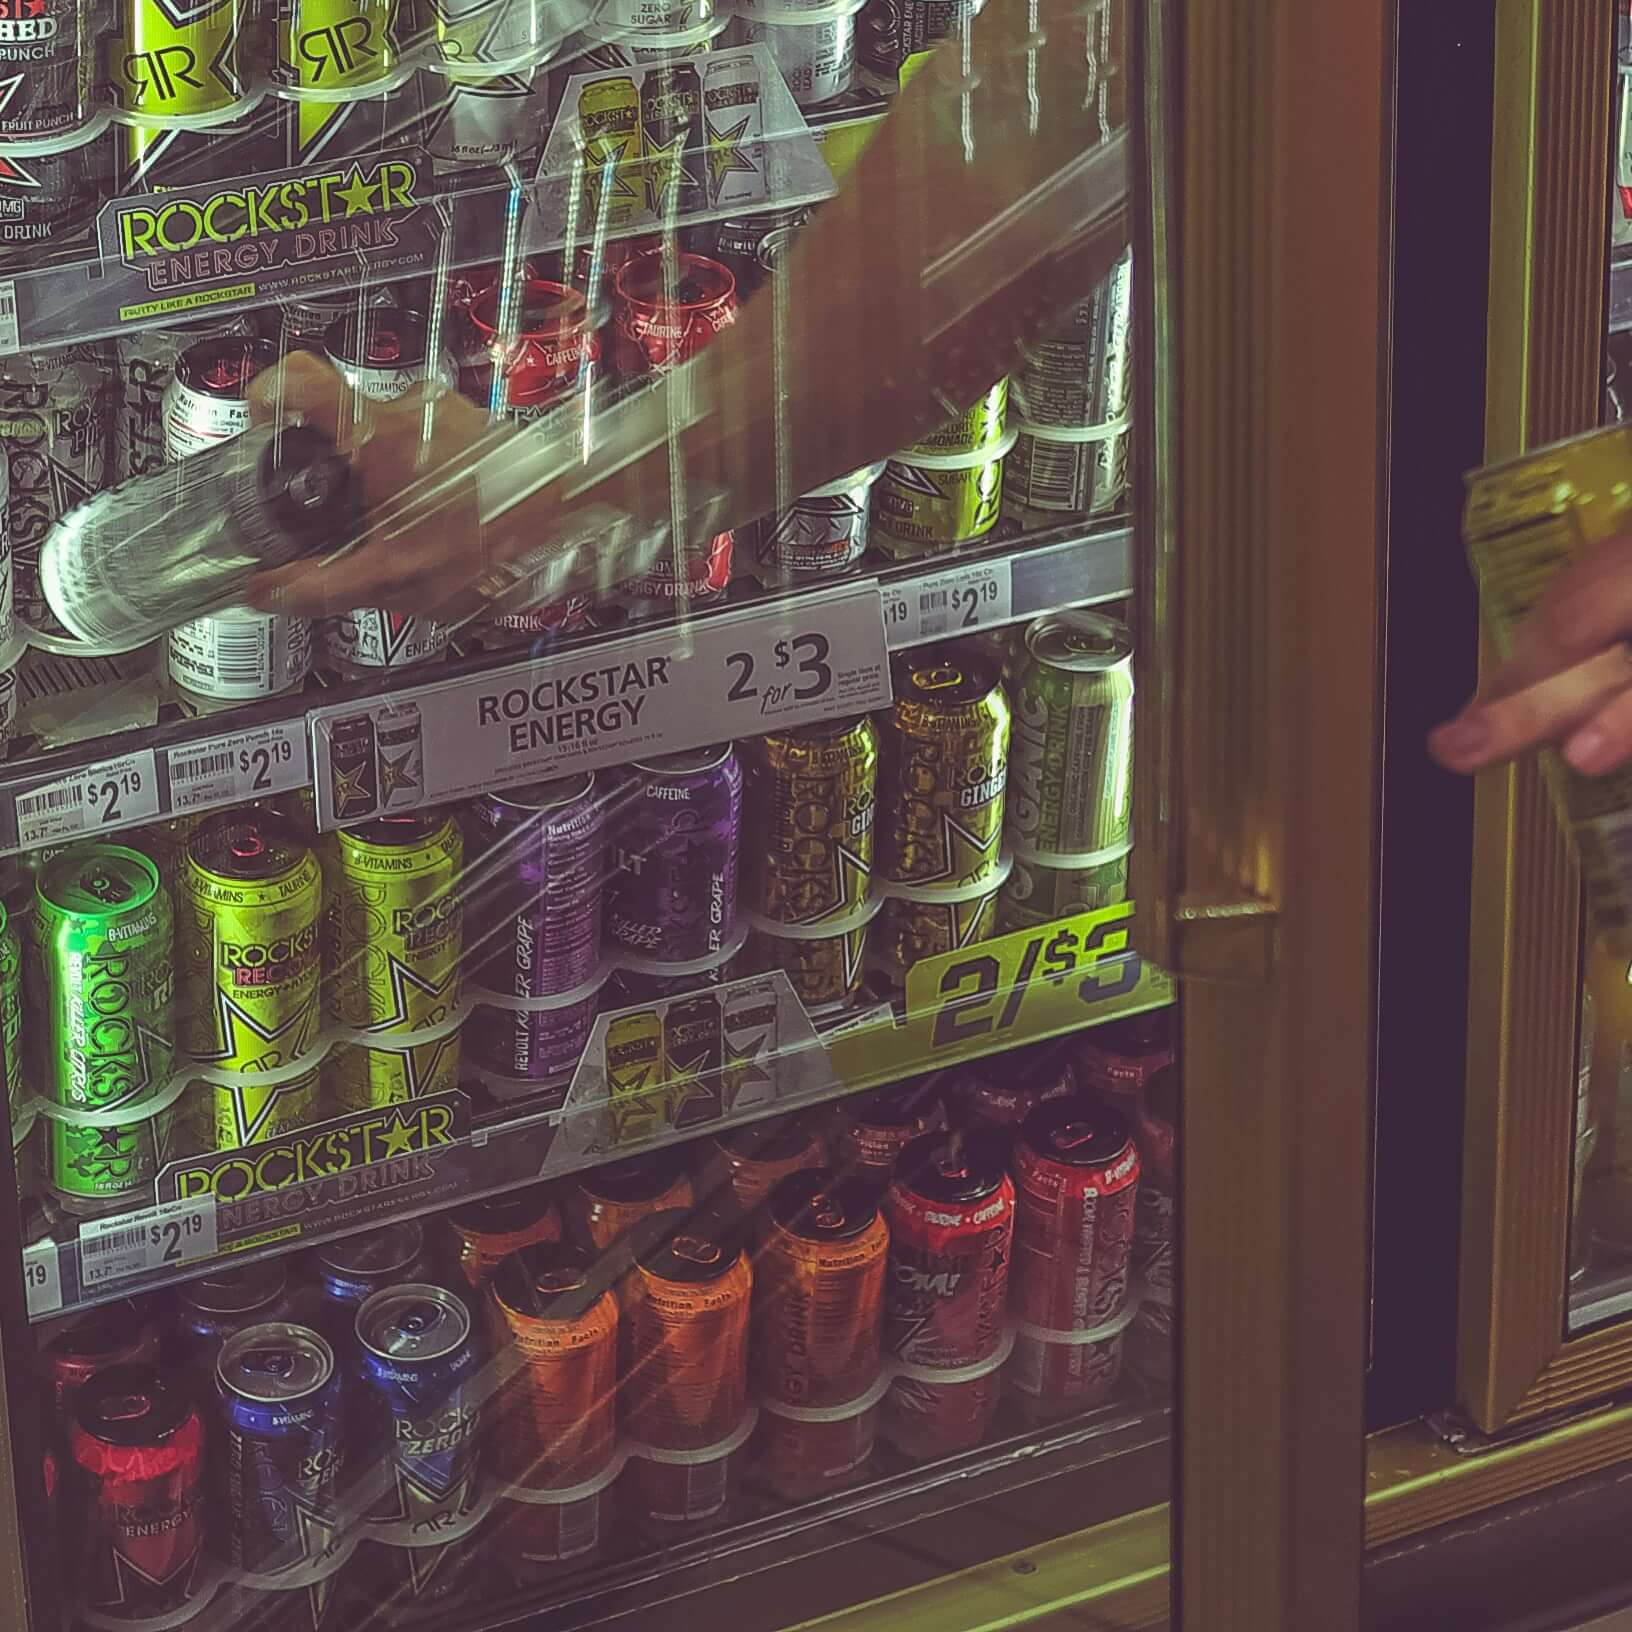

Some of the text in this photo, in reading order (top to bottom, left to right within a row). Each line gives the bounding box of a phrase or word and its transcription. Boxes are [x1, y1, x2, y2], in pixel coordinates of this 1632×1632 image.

[3, 222, 53, 239] DRINK
[148, 216, 397, 286] ENERGY DRINK
[726, 653, 758, 701] 2
[774, 633, 832, 699] $3
[478, 655, 672, 726] ROCKSTAR
[760, 680, 794, 714] for
[509, 697, 646, 753] ENERGY
[709, 871, 725, 917] GRAPE
[516, 917, 534, 963] GRAPE
